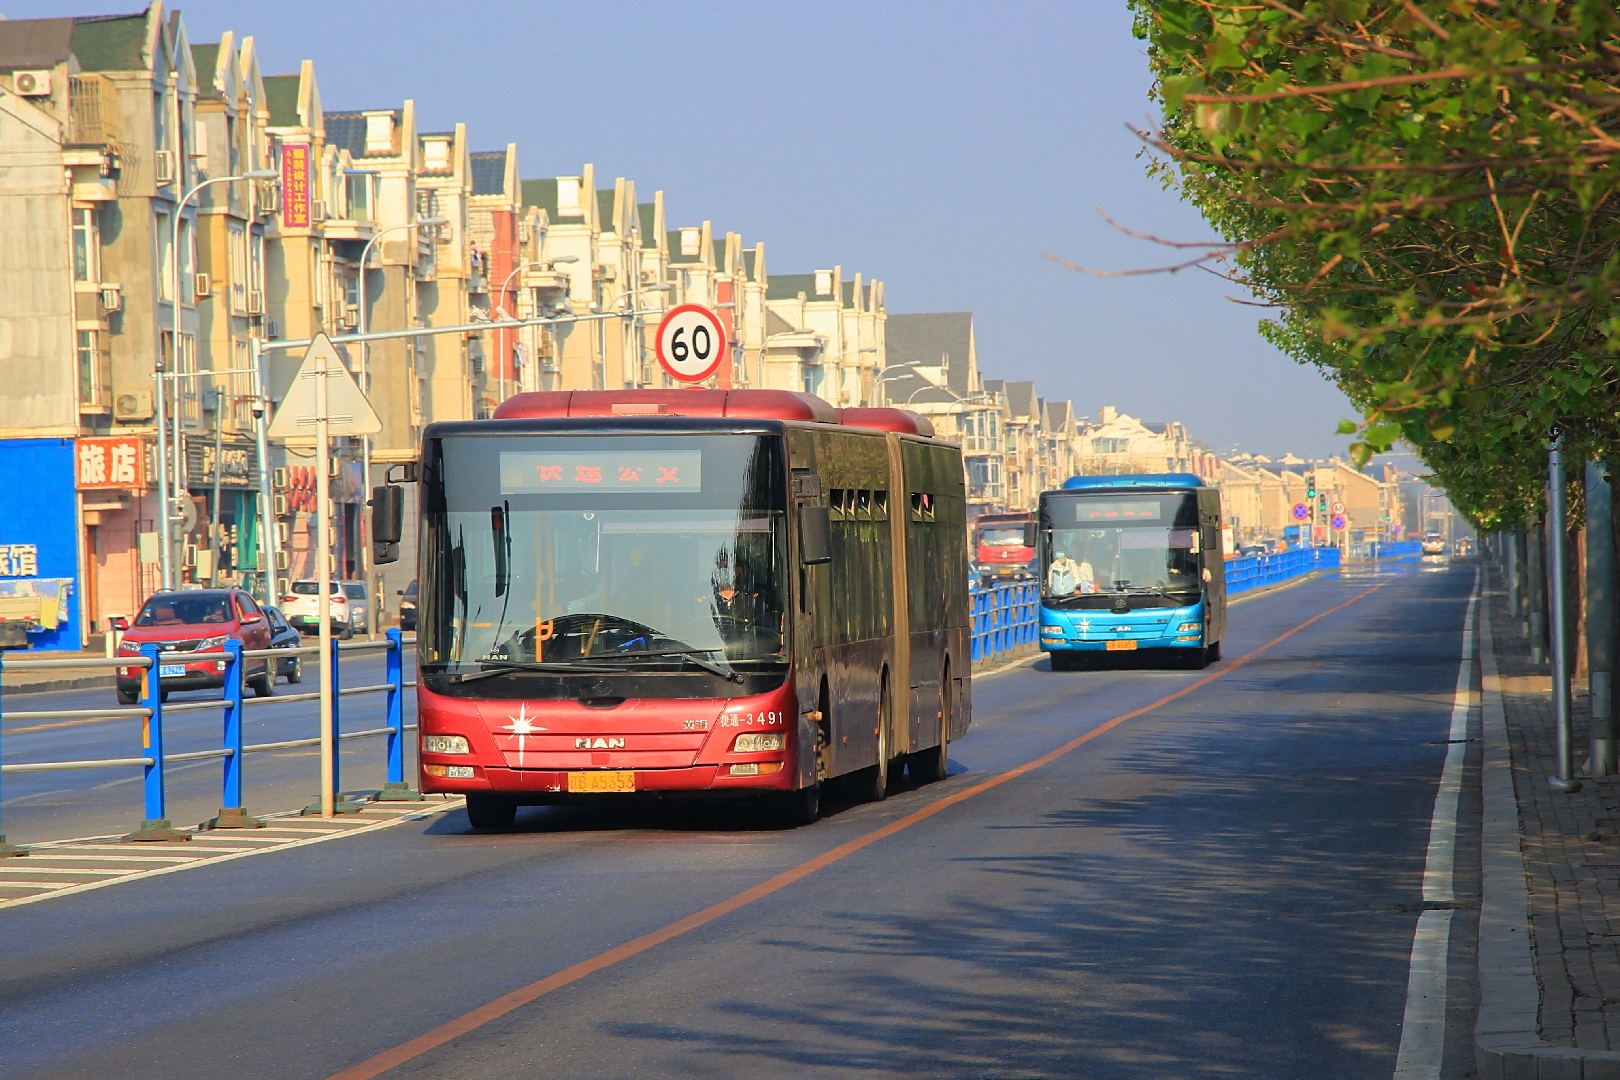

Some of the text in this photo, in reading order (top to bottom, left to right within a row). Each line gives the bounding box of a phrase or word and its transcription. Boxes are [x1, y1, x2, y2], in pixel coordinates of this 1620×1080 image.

[293, 148, 306, 224] 服装设计工作室
[671, 325, 711, 362] 60
[80, 444, 136, 484] 旅店
[574, 738, 625, 749] MAN
